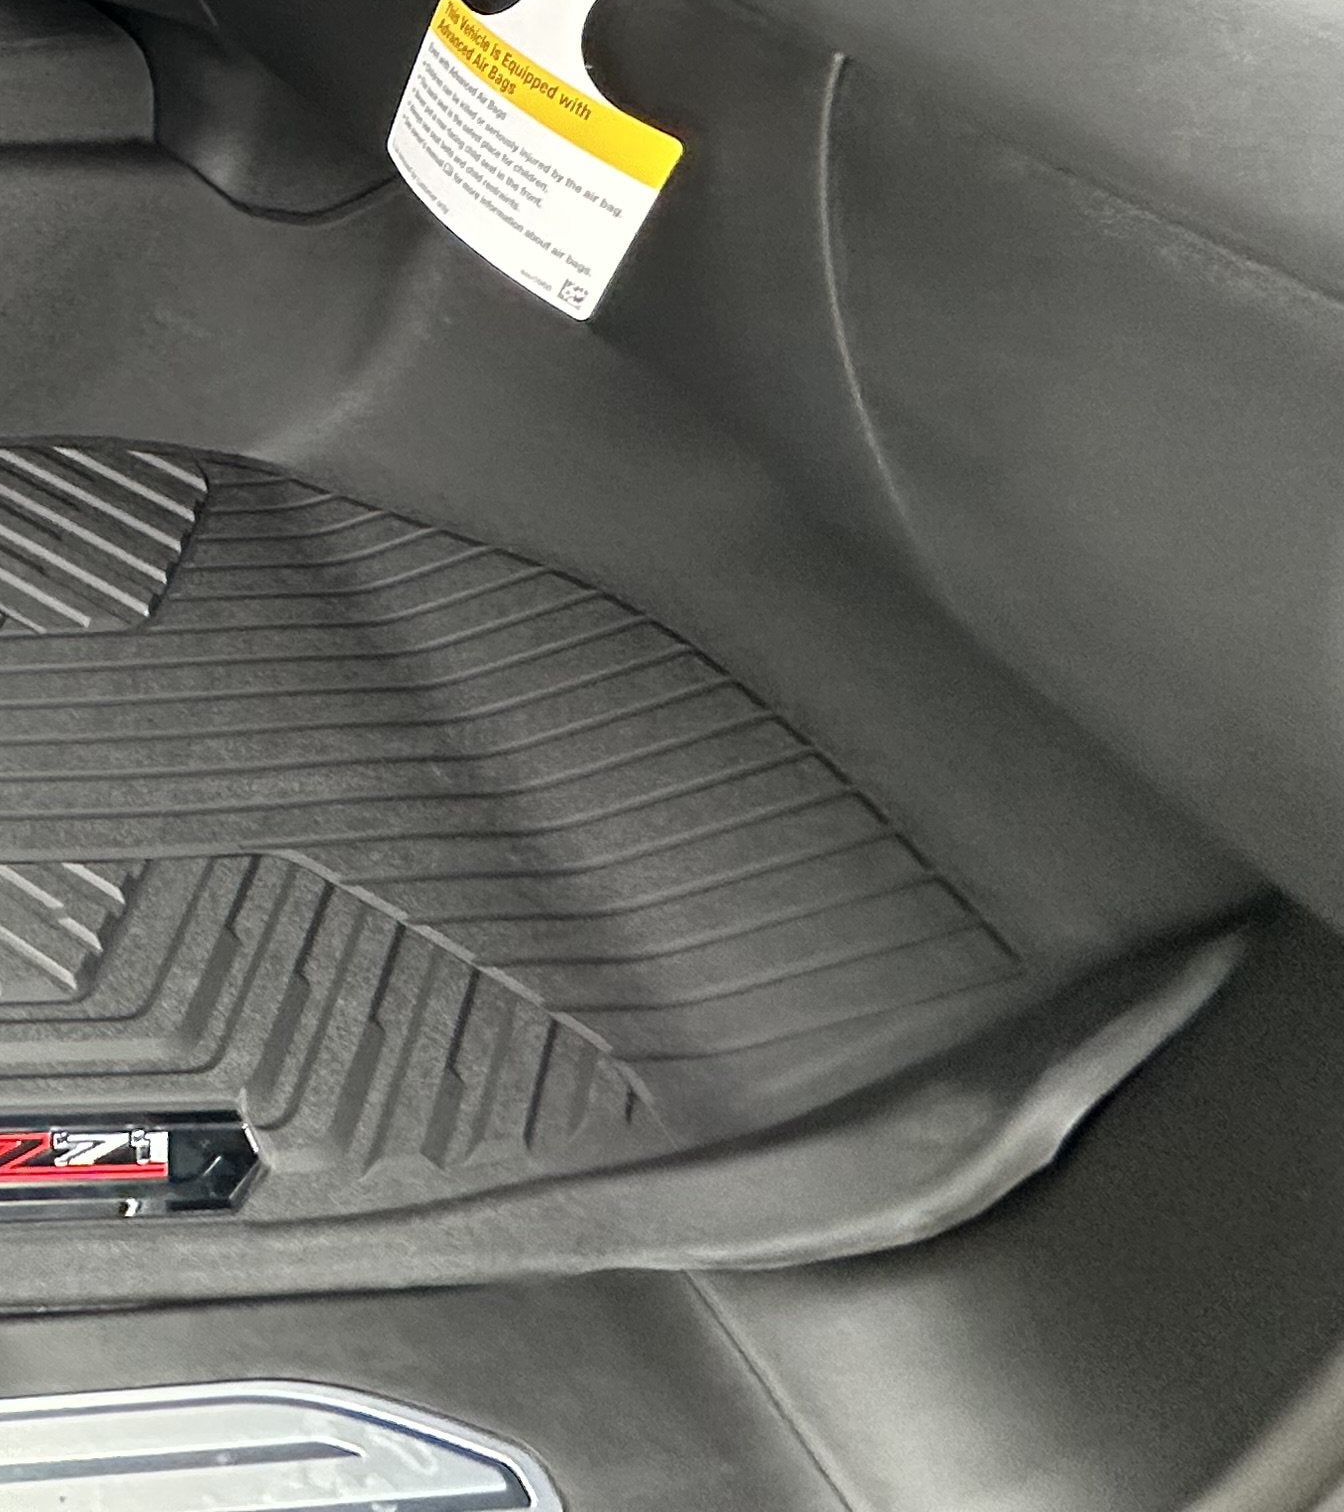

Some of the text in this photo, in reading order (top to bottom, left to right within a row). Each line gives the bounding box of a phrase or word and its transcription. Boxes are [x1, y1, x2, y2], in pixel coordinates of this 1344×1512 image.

[437, 18, 516, 95] Advanced Air Bags
[445, 1, 460, 24] This
[460, 16, 490, 52] Vehicle
[502, 52, 559, 99] Equipped
[559, 94, 591, 120] with
